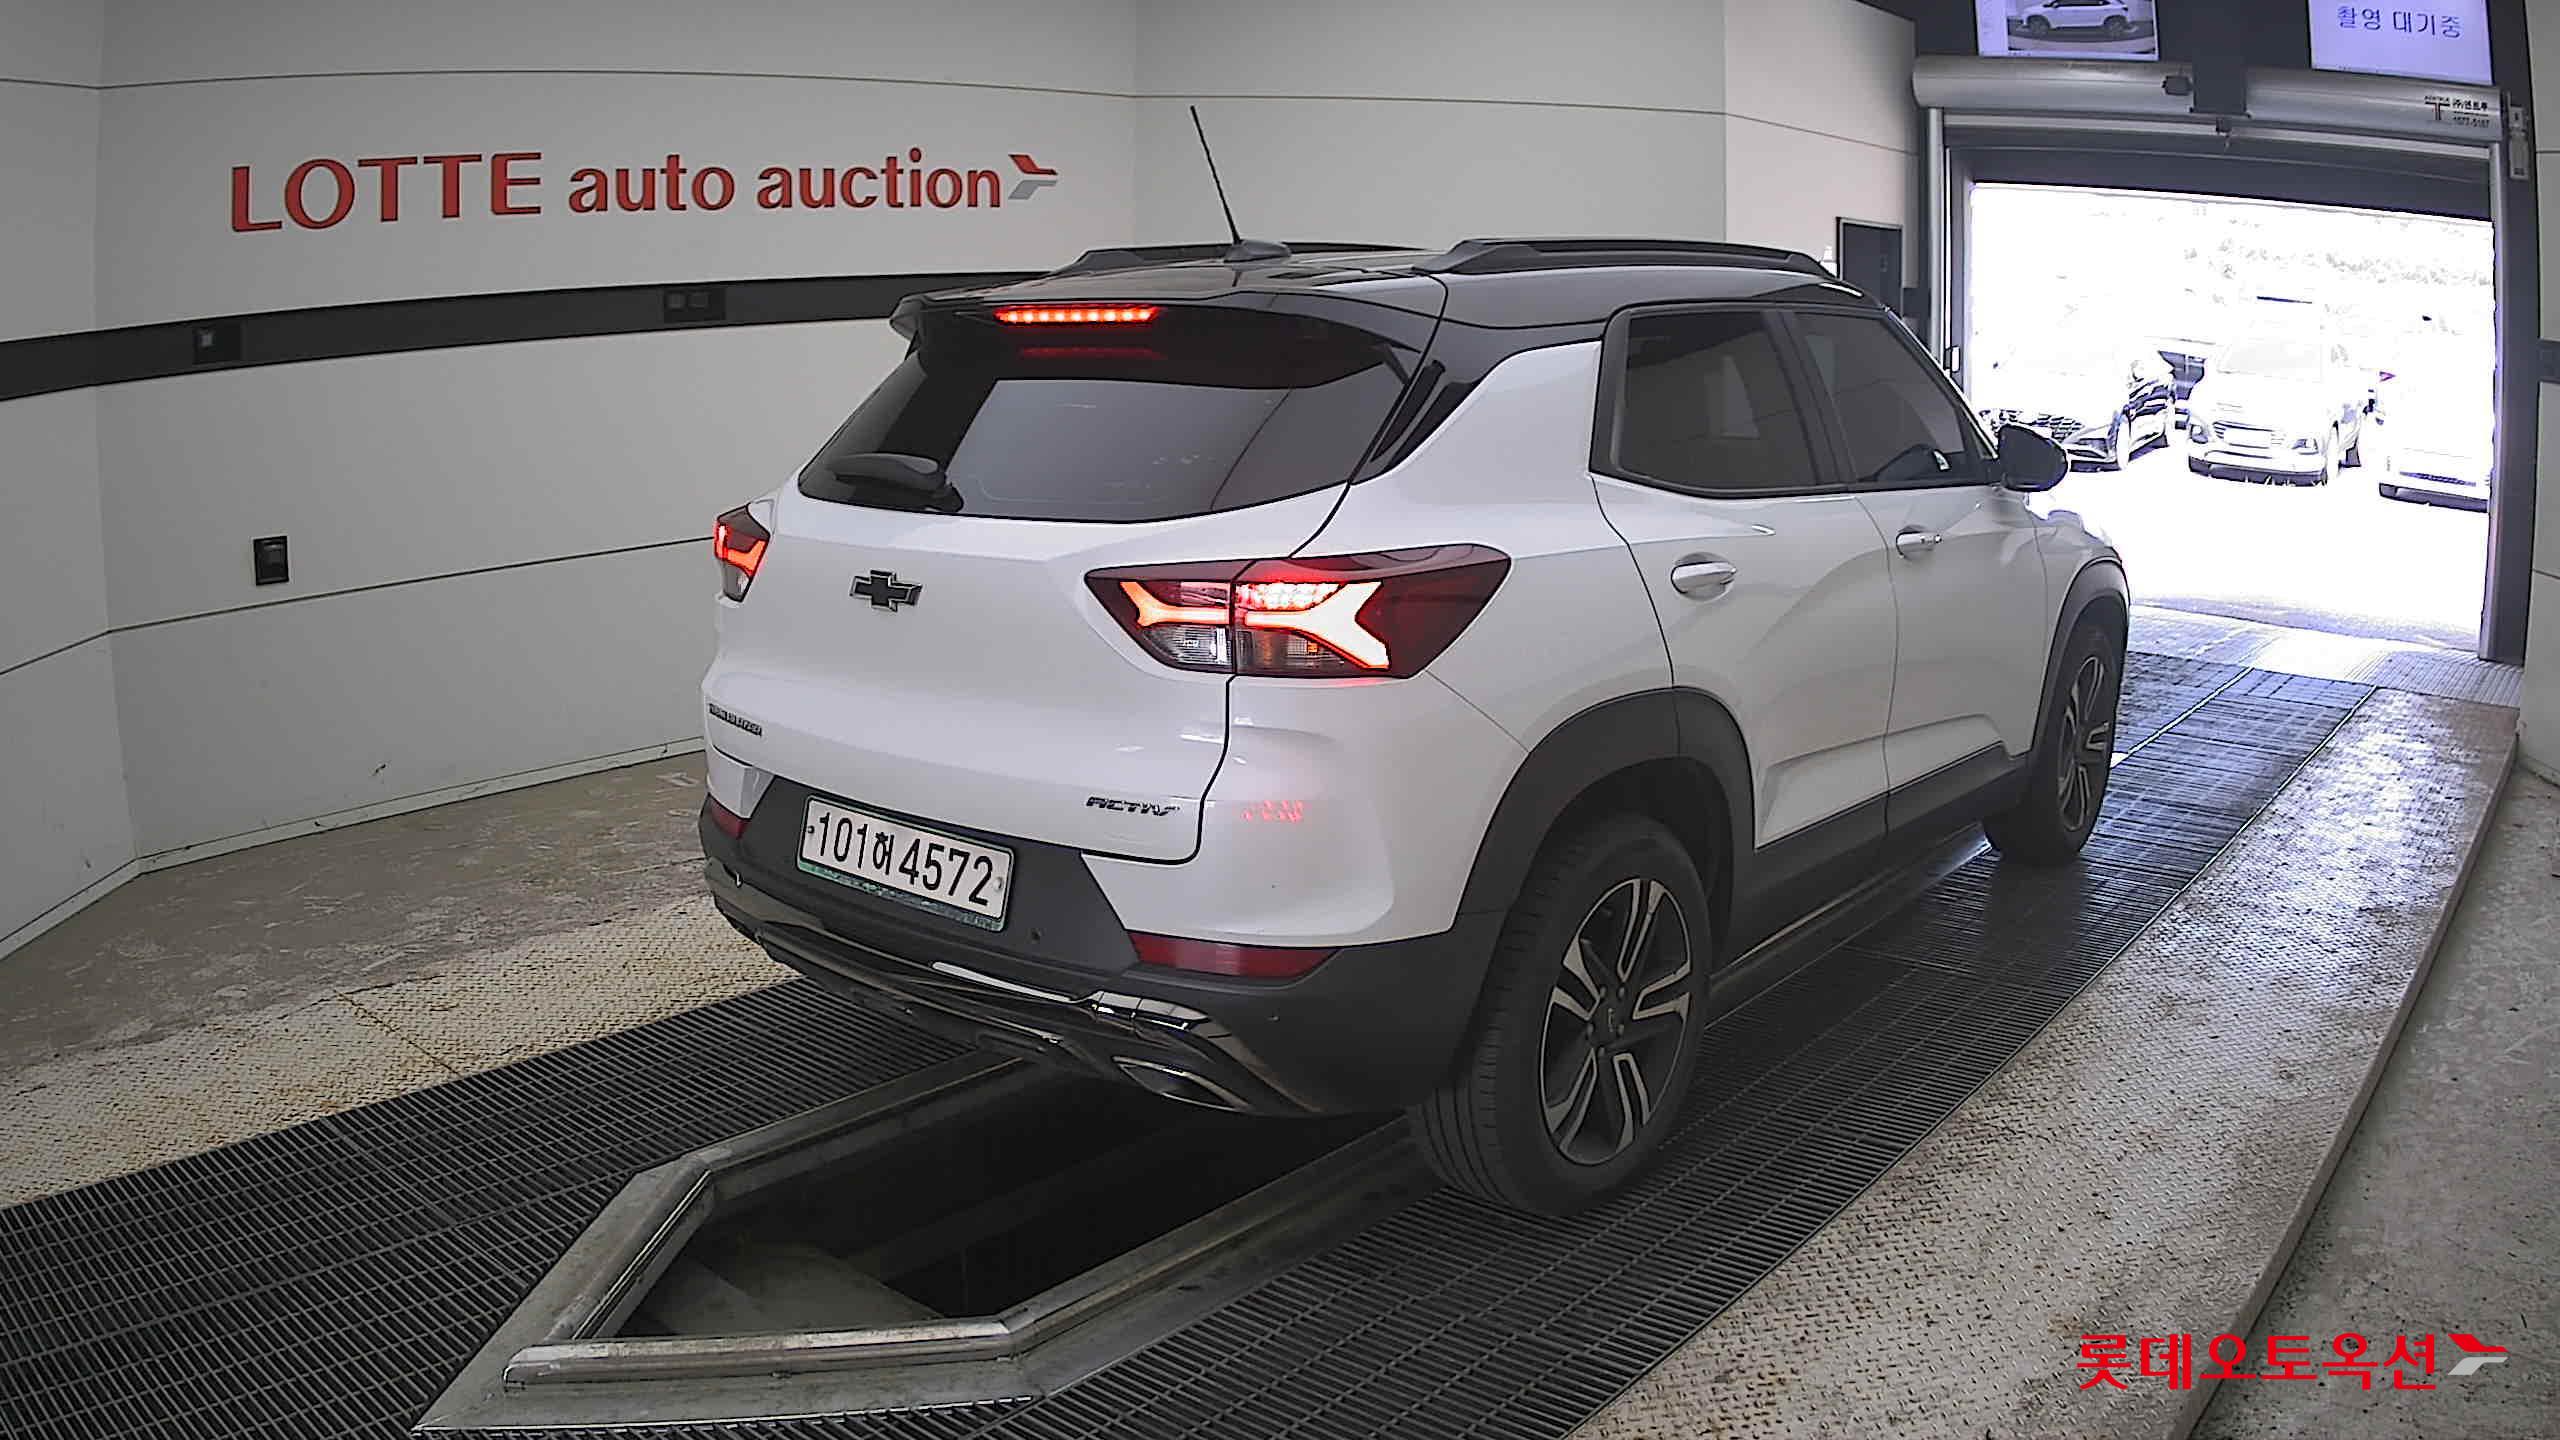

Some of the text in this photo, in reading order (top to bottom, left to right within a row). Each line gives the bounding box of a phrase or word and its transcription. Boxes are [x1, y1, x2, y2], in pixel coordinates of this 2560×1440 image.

[2392, 11, 2460, 38] 대기중
[231, 147, 1001, 232] LOTTE auto auction
